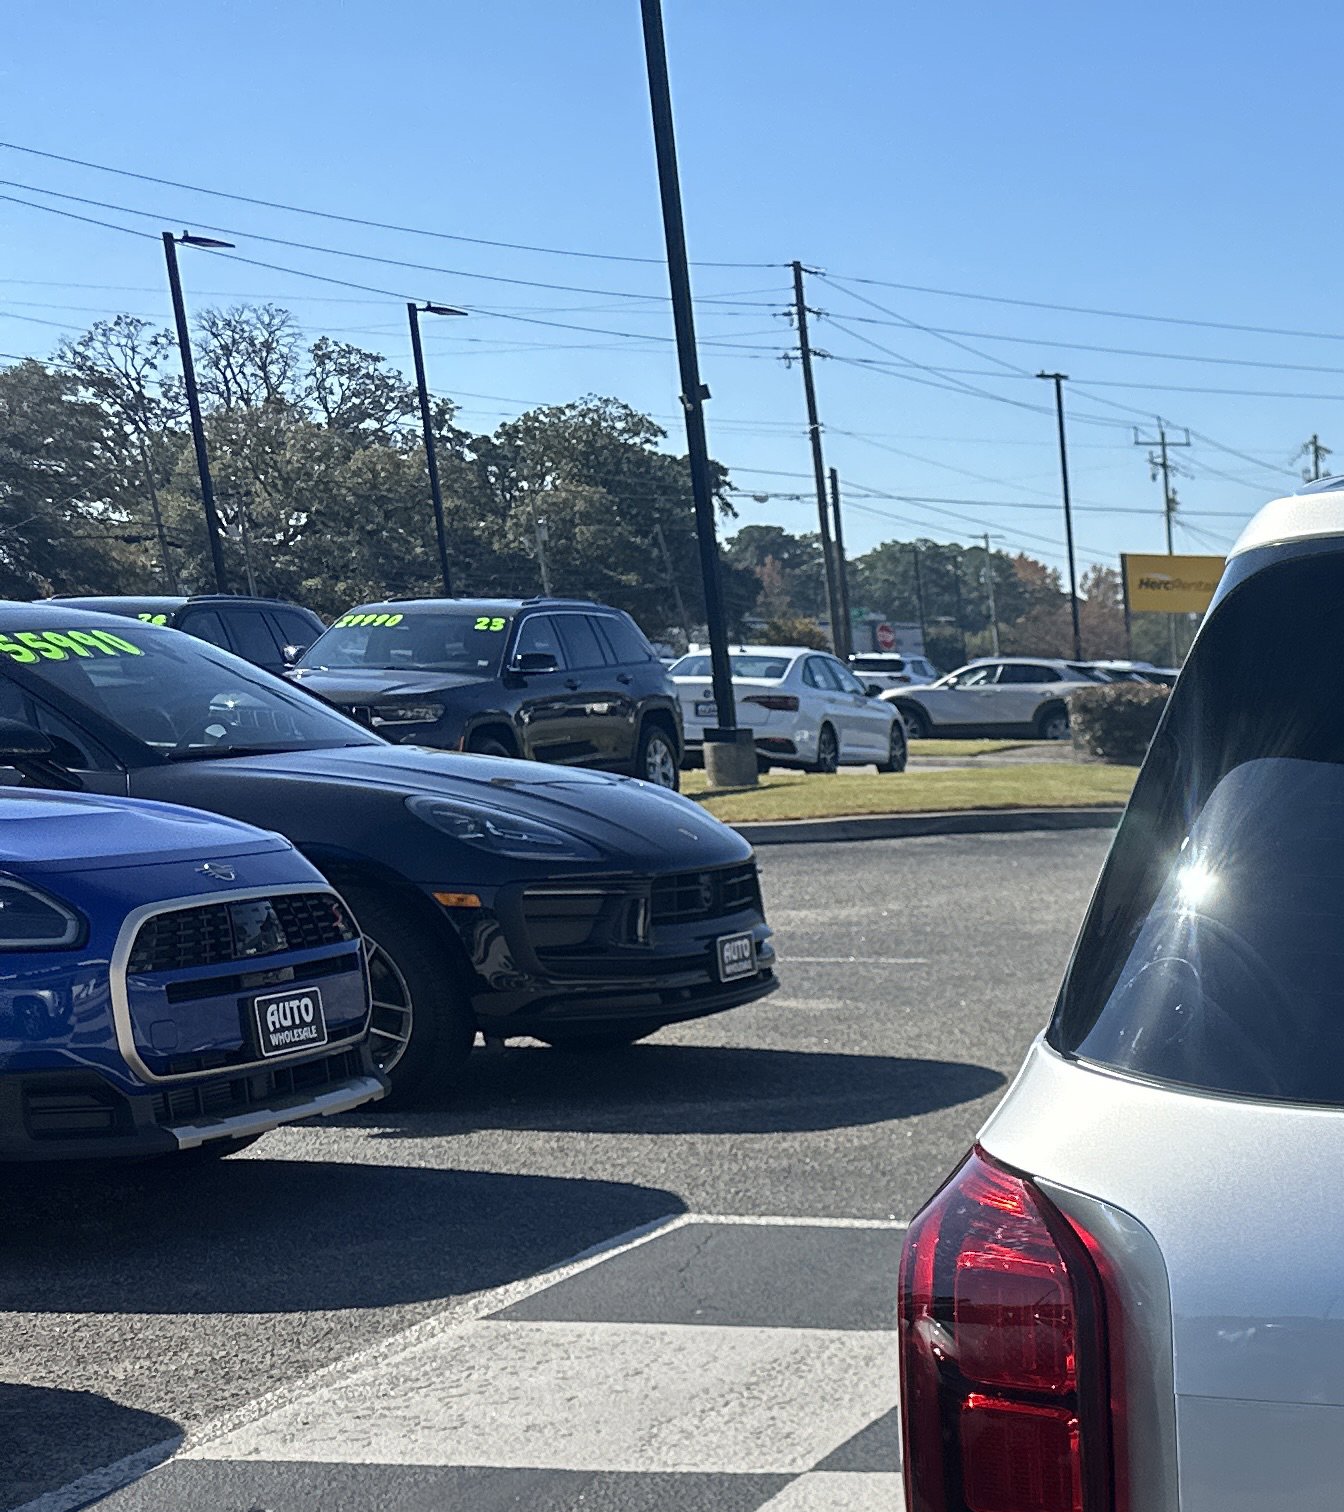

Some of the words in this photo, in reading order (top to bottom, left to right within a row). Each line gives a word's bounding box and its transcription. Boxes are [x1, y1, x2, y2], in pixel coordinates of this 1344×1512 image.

[474, 617, 506, 631] 23
[266, 997, 314, 1032] AUTO
[269, 1025, 318, 1047] WHOLESALE
